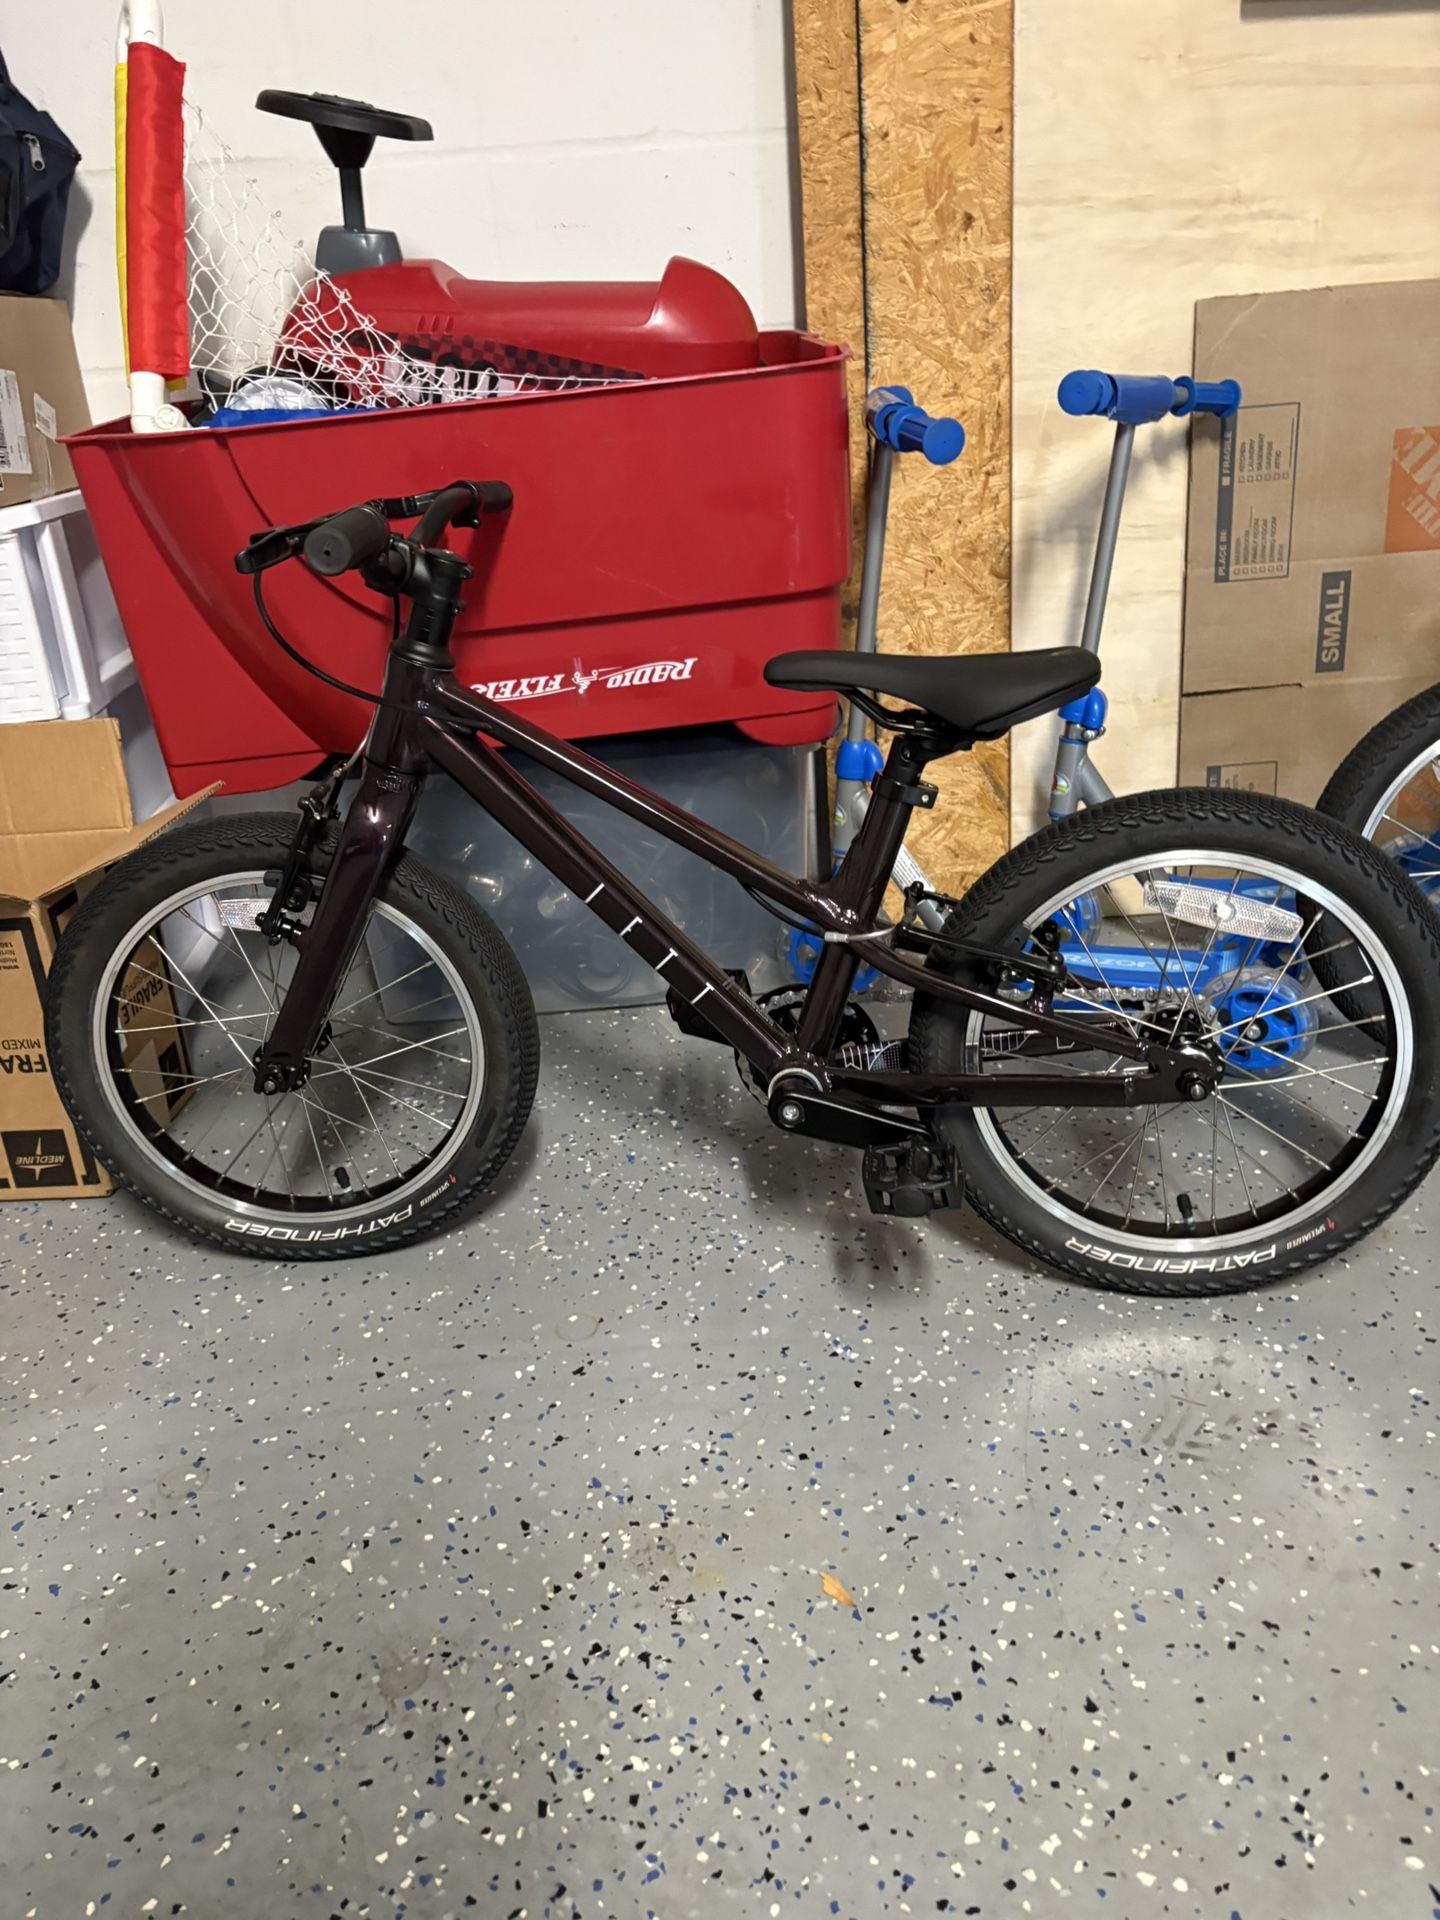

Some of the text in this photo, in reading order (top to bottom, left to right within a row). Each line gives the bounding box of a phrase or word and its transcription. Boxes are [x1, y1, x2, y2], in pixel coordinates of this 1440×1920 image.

[1222, 431, 1233, 474] FRAGILE
[1217, 545, 1228, 577] PLACE
[1322, 580, 1345, 664] SMALL
[606, 657, 699, 690] RADIO
[121, 977, 164, 1025] FRAGILE
[2, 1038, 41, 1051] MIXED
[15, 1154, 66, 1165] MEDLINE
[224, 1203, 414, 1243] PATHFINDER
[1064, 1235, 1277, 1275] PATHFINDER
